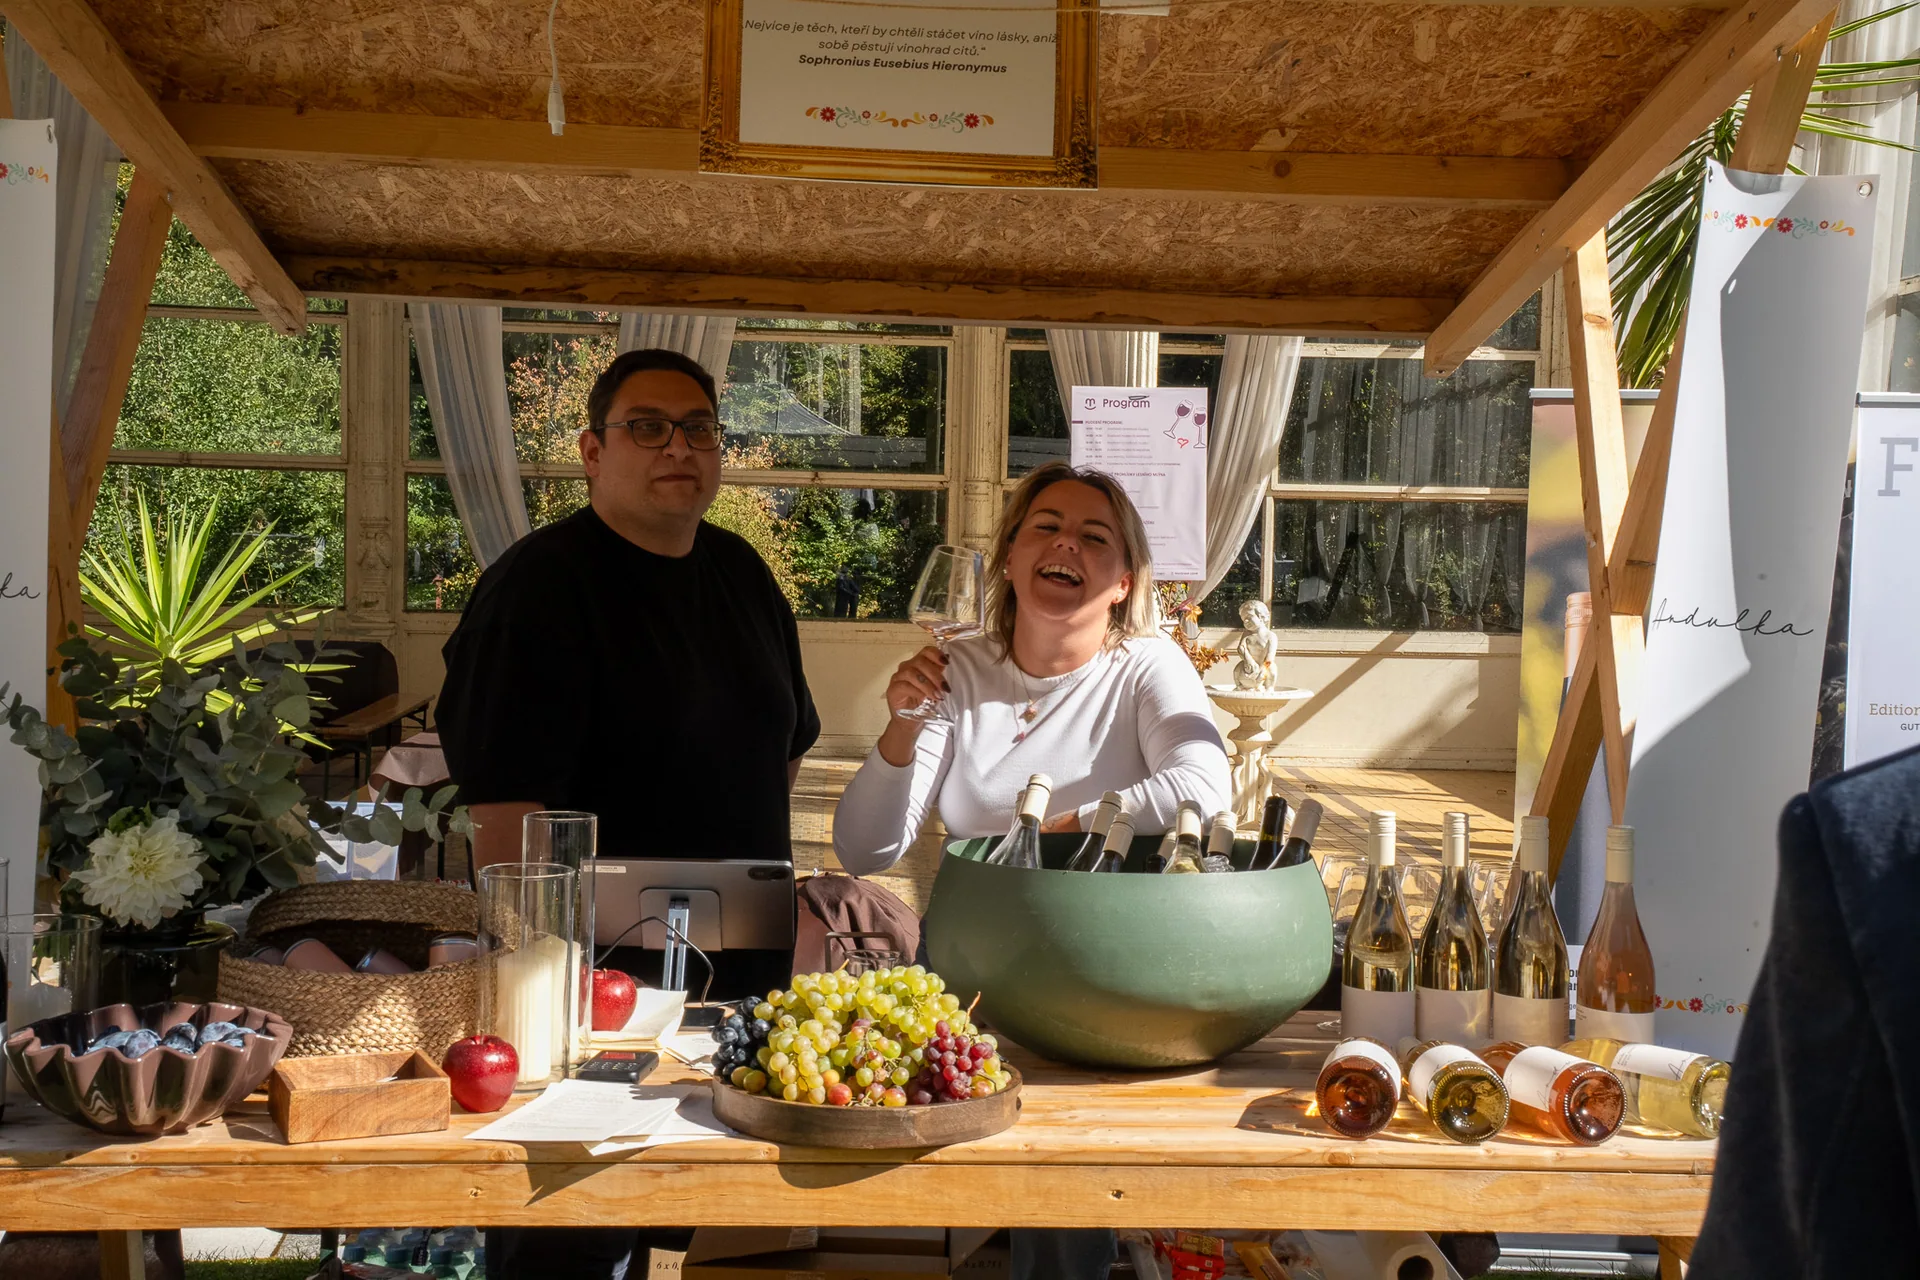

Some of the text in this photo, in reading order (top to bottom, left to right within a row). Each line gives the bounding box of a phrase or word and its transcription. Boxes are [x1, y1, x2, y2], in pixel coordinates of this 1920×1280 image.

[745, 20, 791, 32] Nejvíce
[791, 22, 804, 33] je
[807, 23, 838, 35] těch,
[841, 24, 870, 35] kteří
[872, 26, 887, 37] by
[889, 27, 924, 38] chtěli
[926, 29, 966, 40] stáčet
[968, 30, 994, 41] víno
[997, 31, 1029, 44] lásky,
[818, 40, 849, 50] sobě
[851, 41, 894, 54] pěstují
[896, 43, 951, 55] vinohrad
[798, 54, 1008, 74] Sophronius Eusebius Hieronymus
[1103, 398, 1151, 409] Program
[1651, 597, 1814, 636] Andulka
